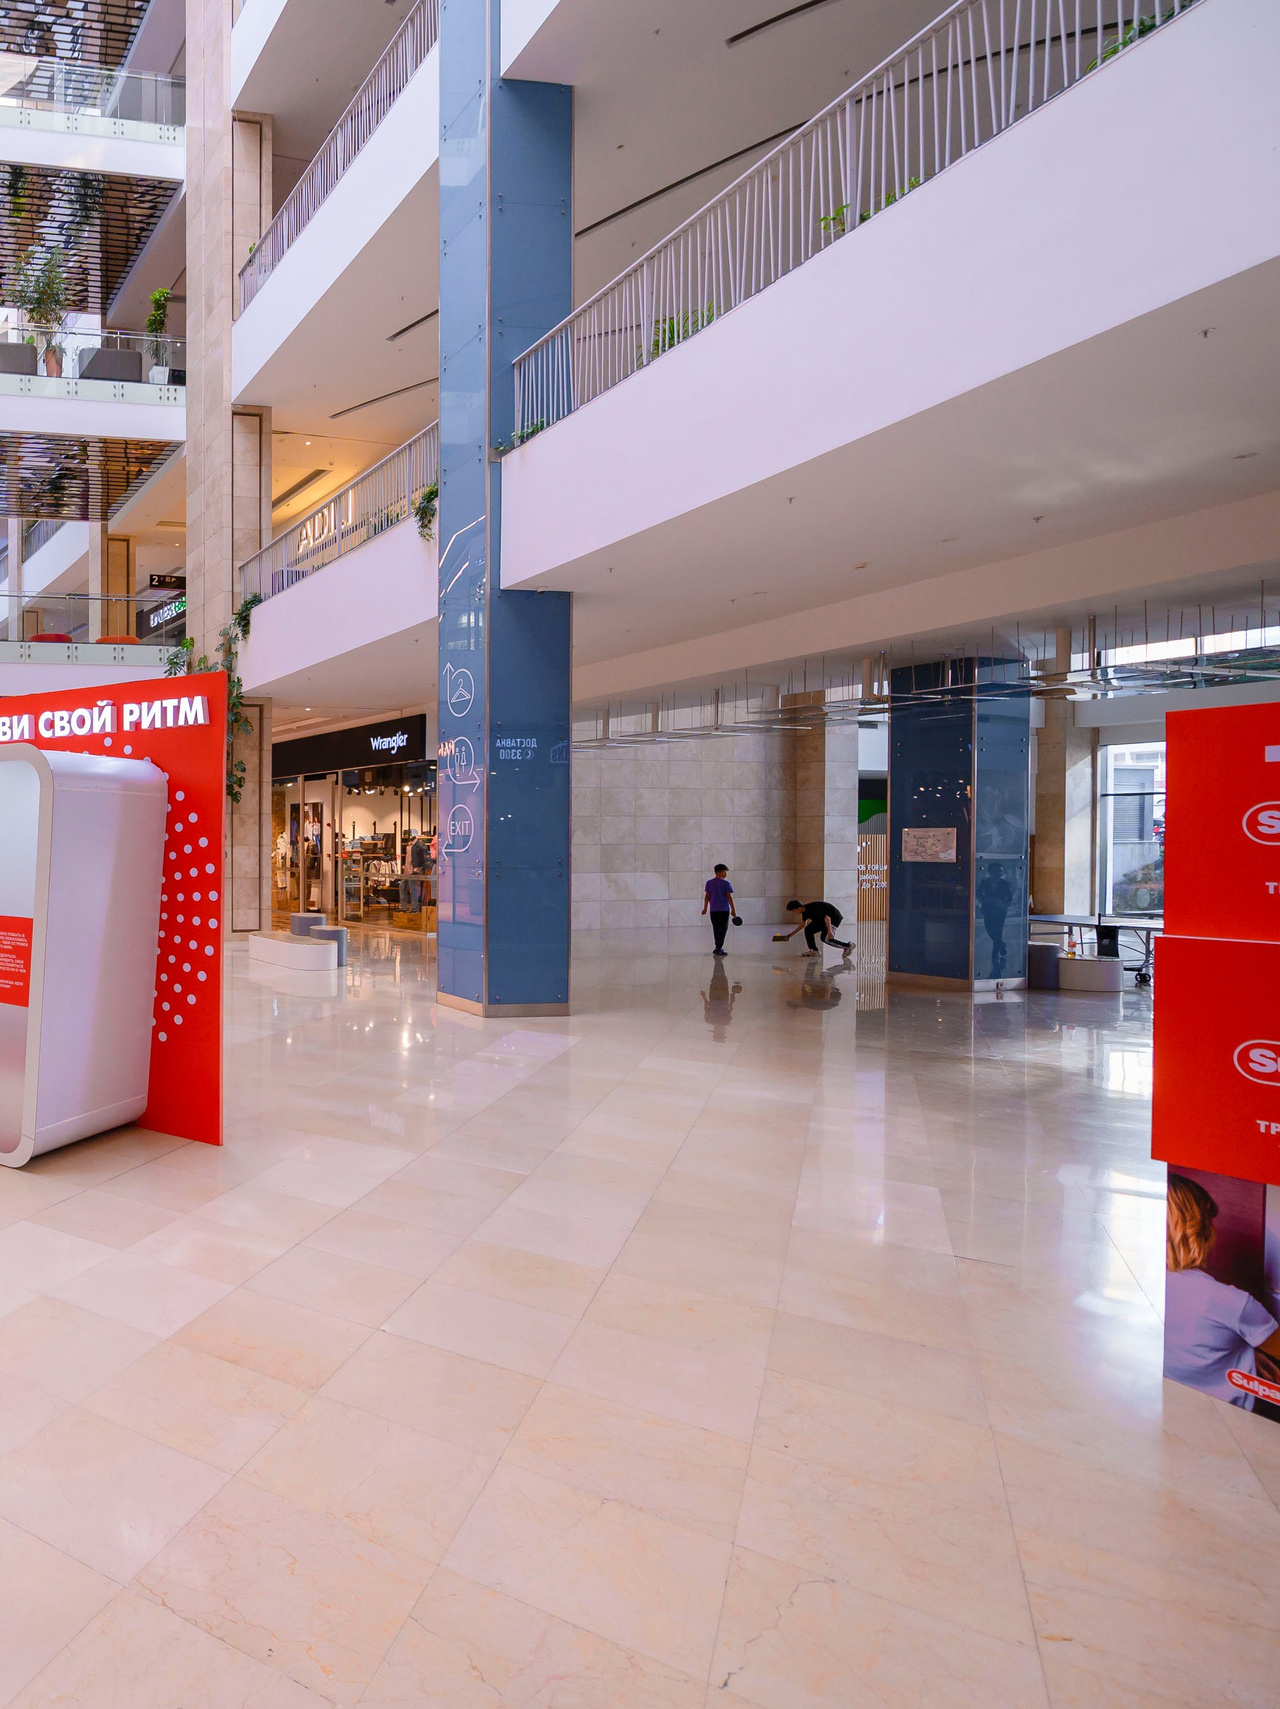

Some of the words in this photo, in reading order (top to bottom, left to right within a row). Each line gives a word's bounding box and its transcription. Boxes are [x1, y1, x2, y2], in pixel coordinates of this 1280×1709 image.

[152, 576, 159, 585] 2
[38, 701, 117, 738] СВОЙ
[123, 695, 209, 731] РИТМ
[370, 731, 408, 755] Wrangler
[451, 821, 470, 836] EXIT
[1249, 1048, 1280, 1073] S
